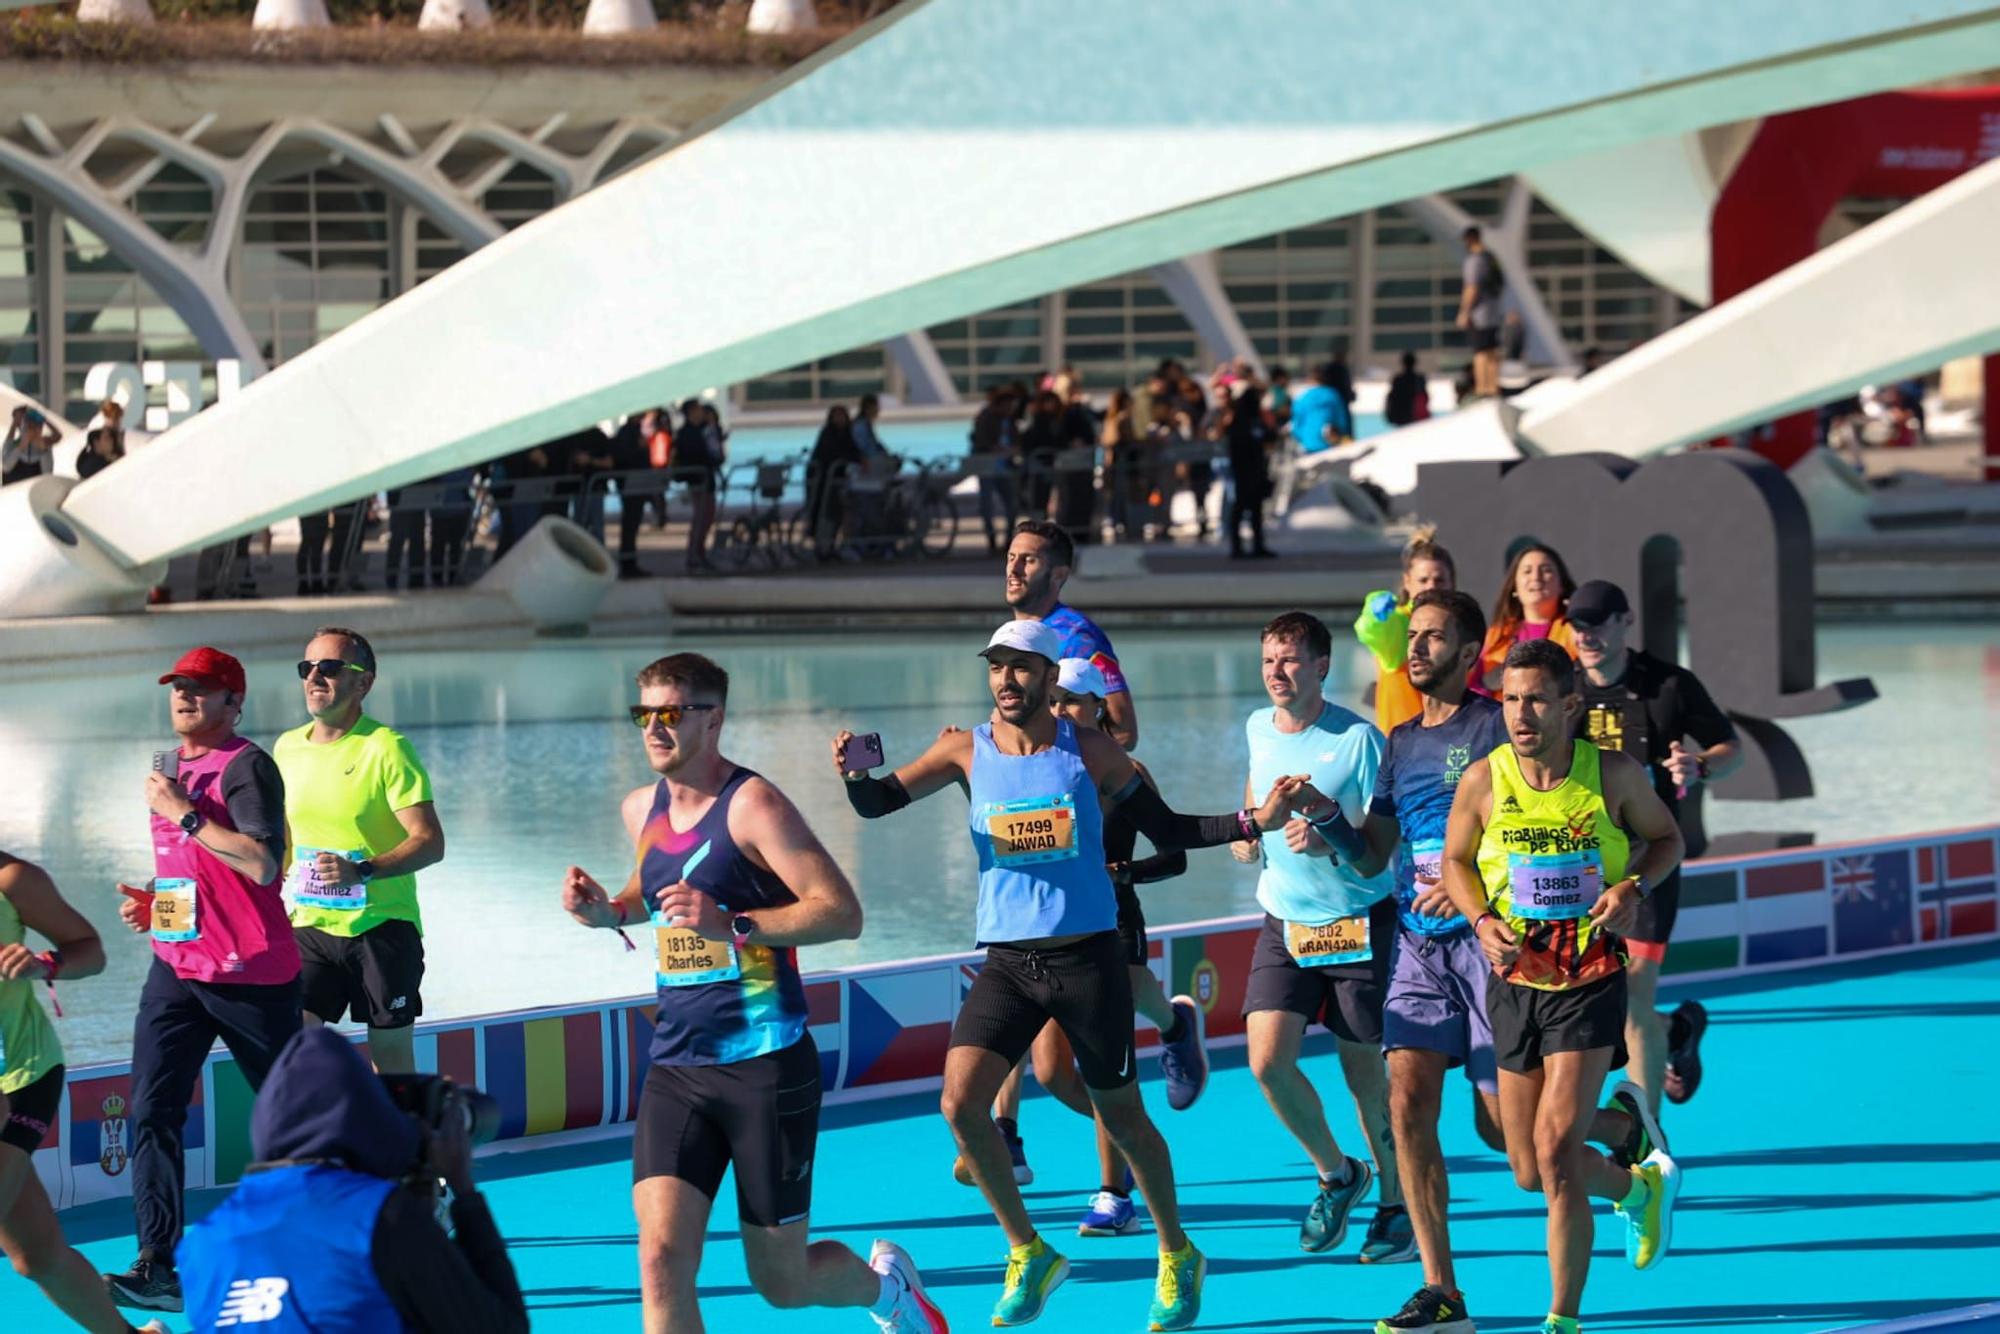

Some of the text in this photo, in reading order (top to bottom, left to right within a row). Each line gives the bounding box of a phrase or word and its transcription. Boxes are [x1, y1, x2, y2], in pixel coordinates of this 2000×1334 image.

[1008, 819, 1053, 836] 17499
[1008, 835, 1056, 852] JAWAD
[1532, 876, 1580, 890] 13863
[1533, 892, 1581, 905] Gomez
[667, 936, 705, 952] 18135
[1298, 938, 1357, 954] GRAN420
[667, 954, 713, 969] Charles
